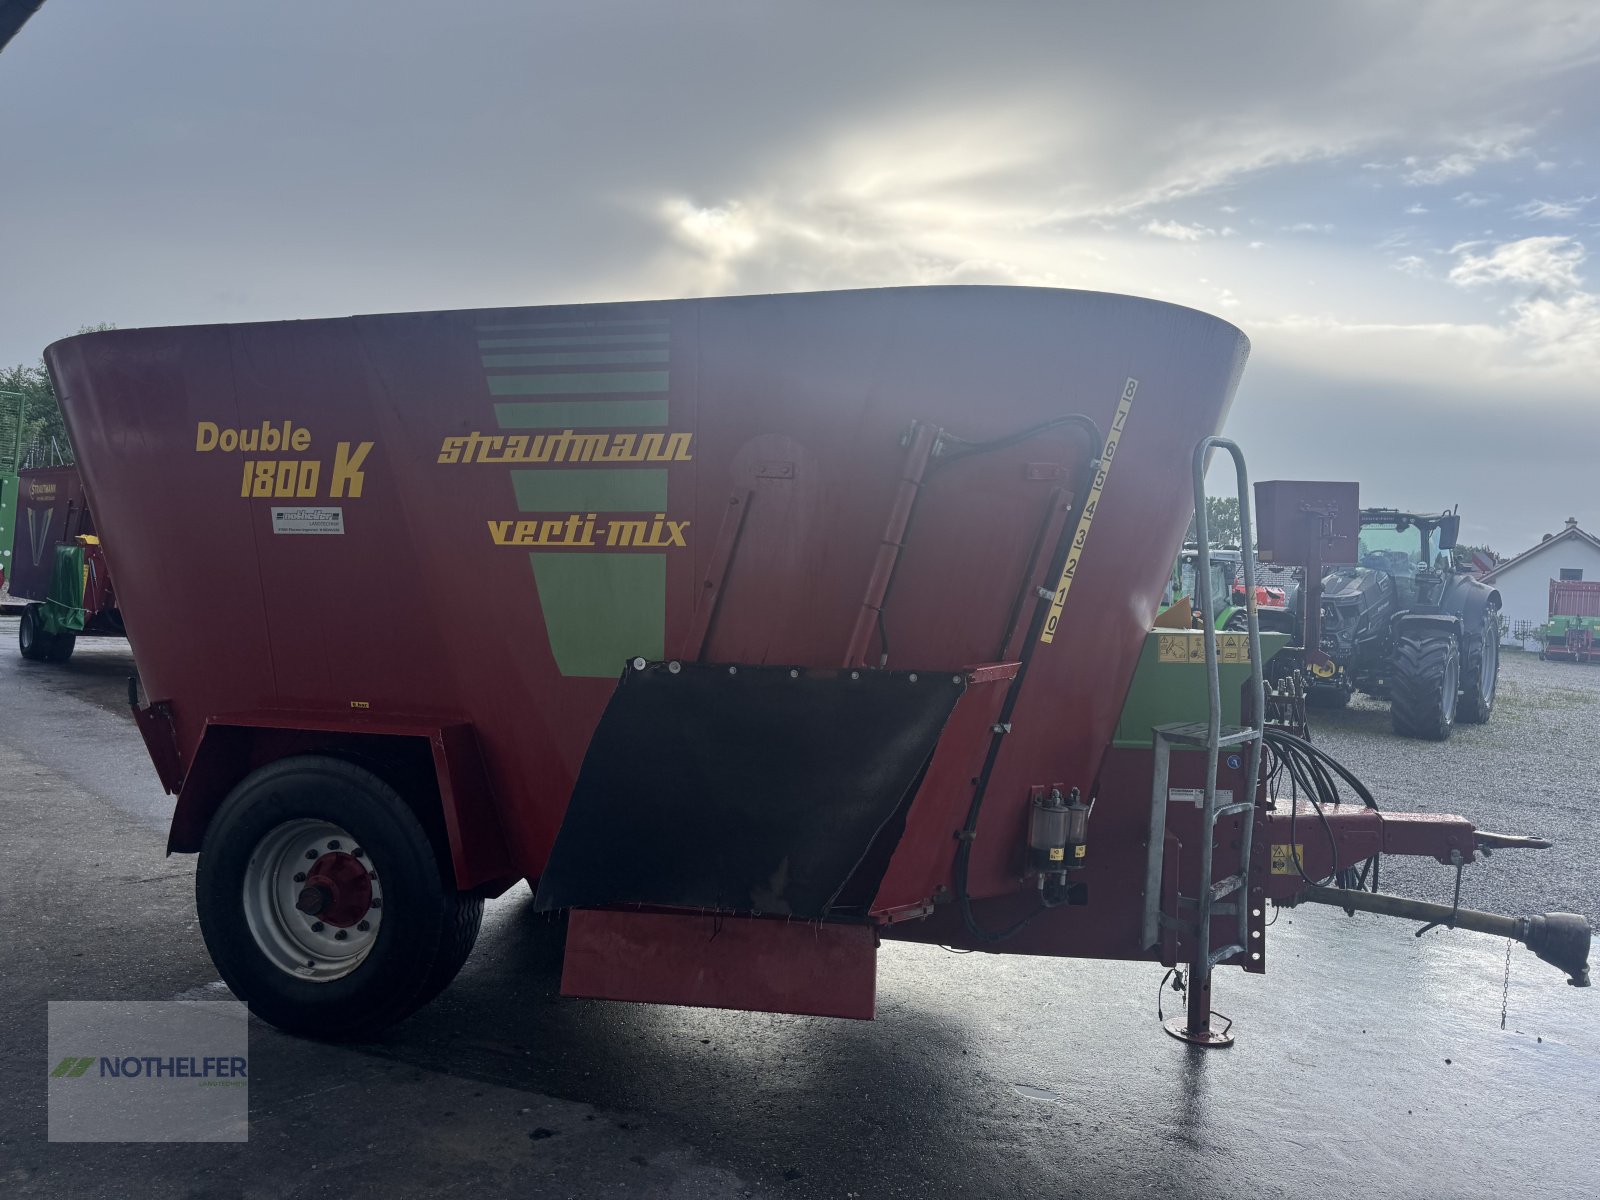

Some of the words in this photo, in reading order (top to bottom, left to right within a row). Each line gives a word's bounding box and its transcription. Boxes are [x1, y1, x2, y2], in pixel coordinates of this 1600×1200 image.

[1125, 380, 1136, 397] 8
[1115, 410, 1127, 427] 7
[196, 420, 311, 452] Double
[437, 429, 693, 463] strautmann
[1105, 440, 1116, 457] 6
[241, 460, 321, 497] 1800
[329, 441, 375, 497] K
[1095, 470, 1106, 487] 5
[1085, 500, 1096, 516] 4
[487, 513, 691, 547] verti-mix
[1076, 529, 1086, 545] 3
[1065, 558, 1077, 575] 2
[1058, 587, 1066, 603] 1
[1048, 615, 1058, 631] 0
